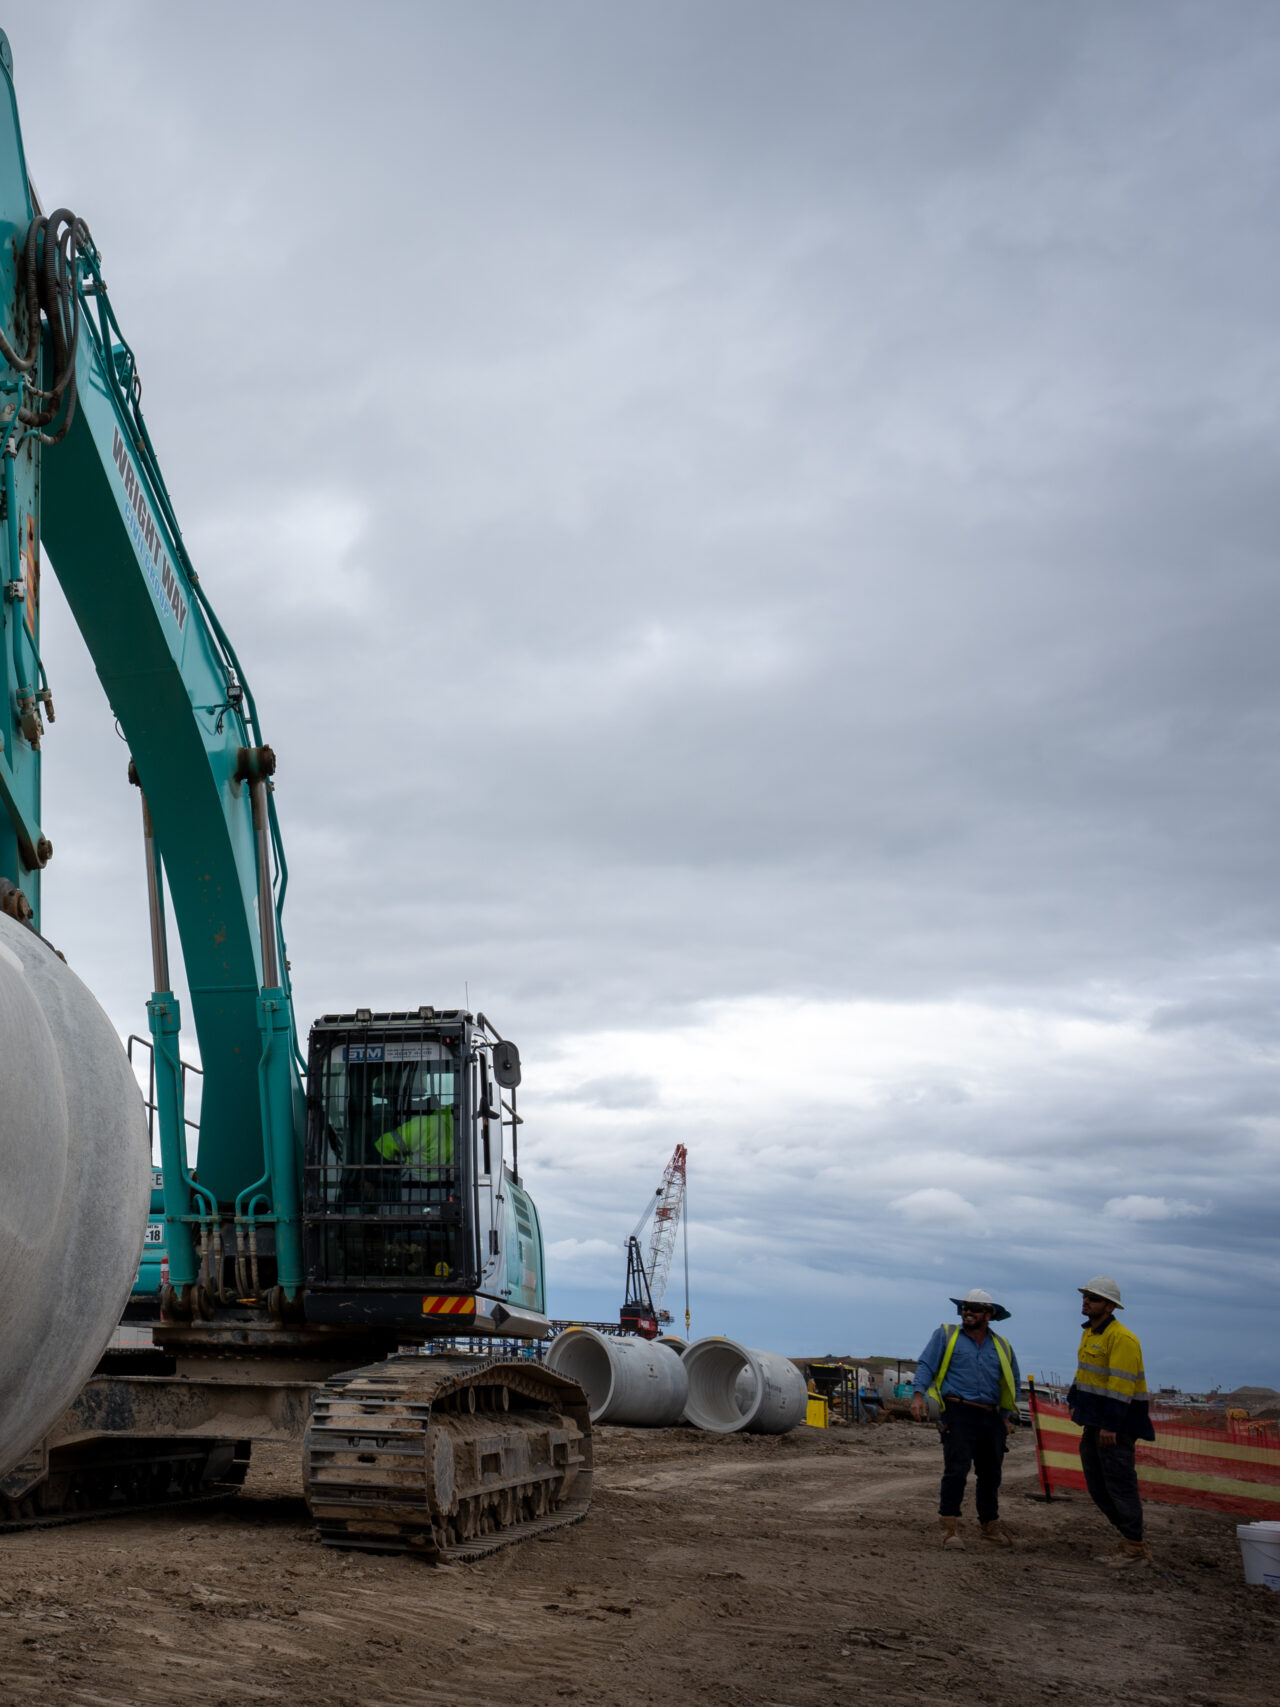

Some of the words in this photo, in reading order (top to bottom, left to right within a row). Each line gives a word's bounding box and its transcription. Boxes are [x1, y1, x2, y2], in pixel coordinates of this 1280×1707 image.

[112, 424, 162, 567] WRIGHT
[161, 552, 188, 631] WAY
[348, 1047, 383, 1059] STM
